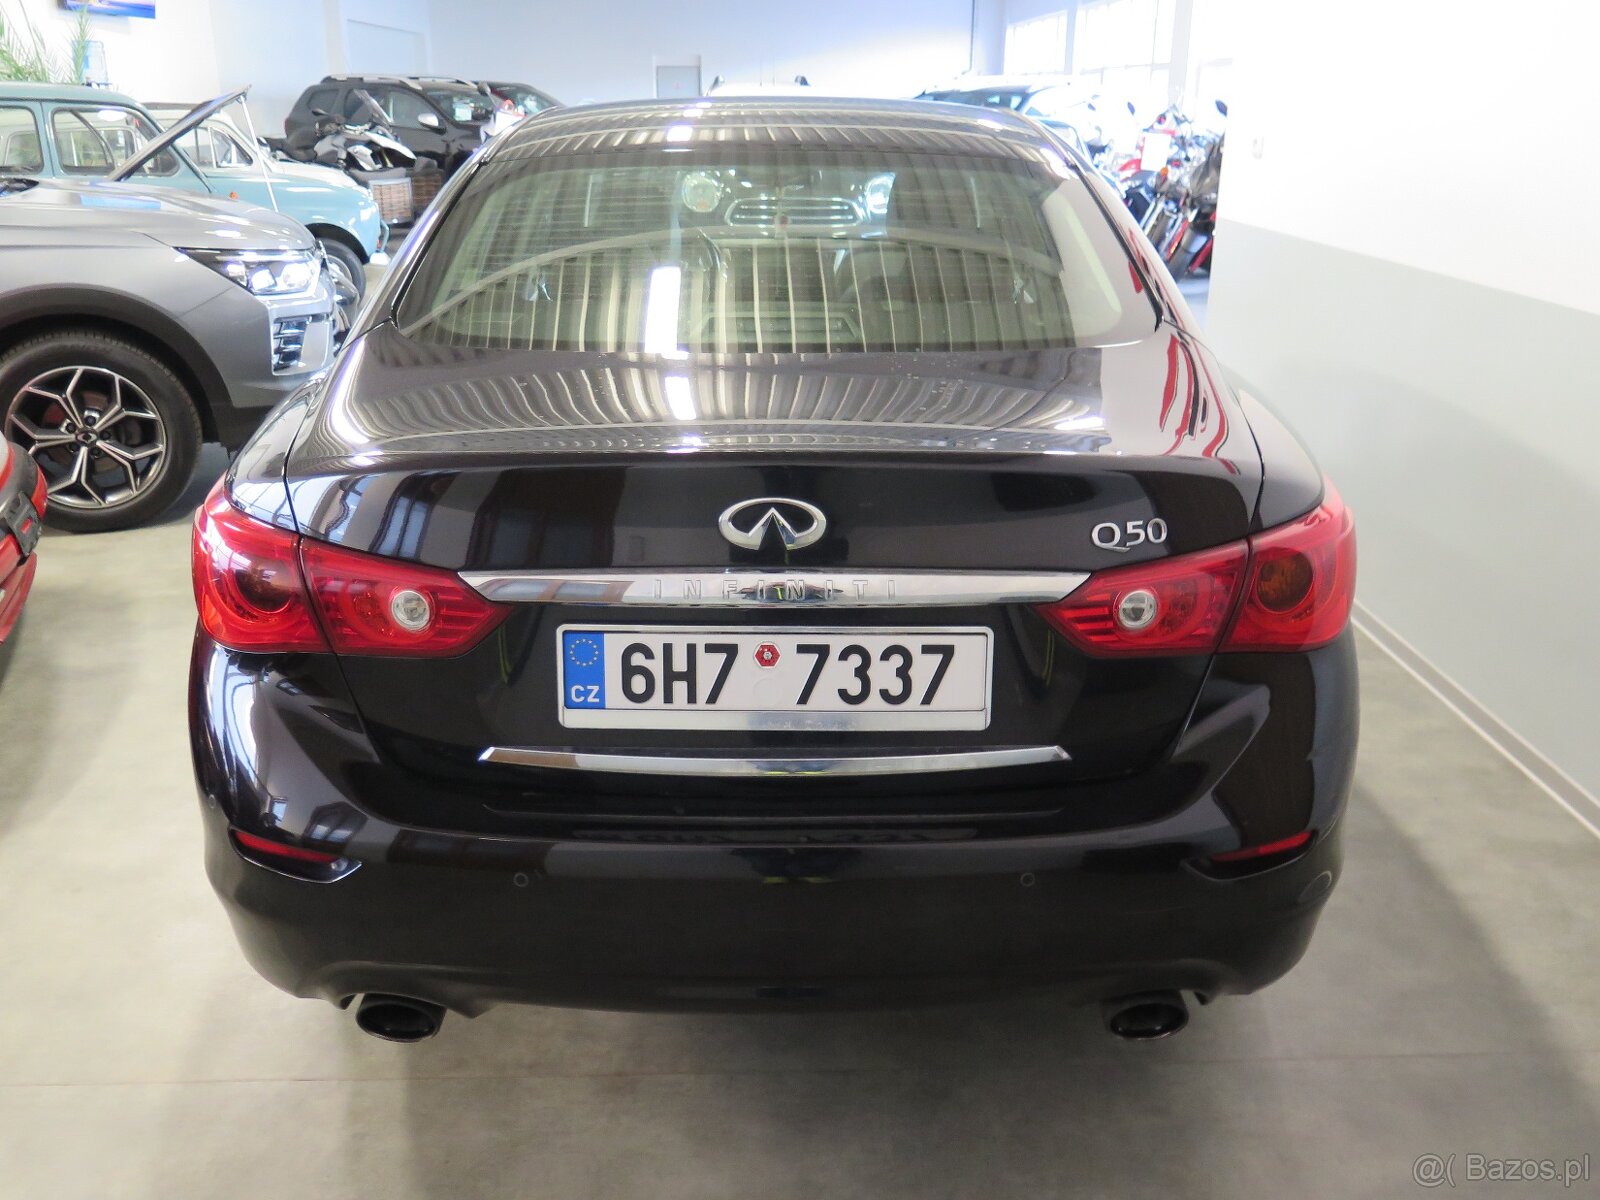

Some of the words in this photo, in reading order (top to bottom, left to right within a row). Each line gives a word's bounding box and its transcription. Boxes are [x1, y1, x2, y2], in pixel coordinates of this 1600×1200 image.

[1091, 518, 1168, 553] Q50
[653, 579, 896, 600] INFINITI
[621, 642, 739, 705] 6H7
[795, 643, 956, 706] 7337
[571, 684, 600, 703] CZ
